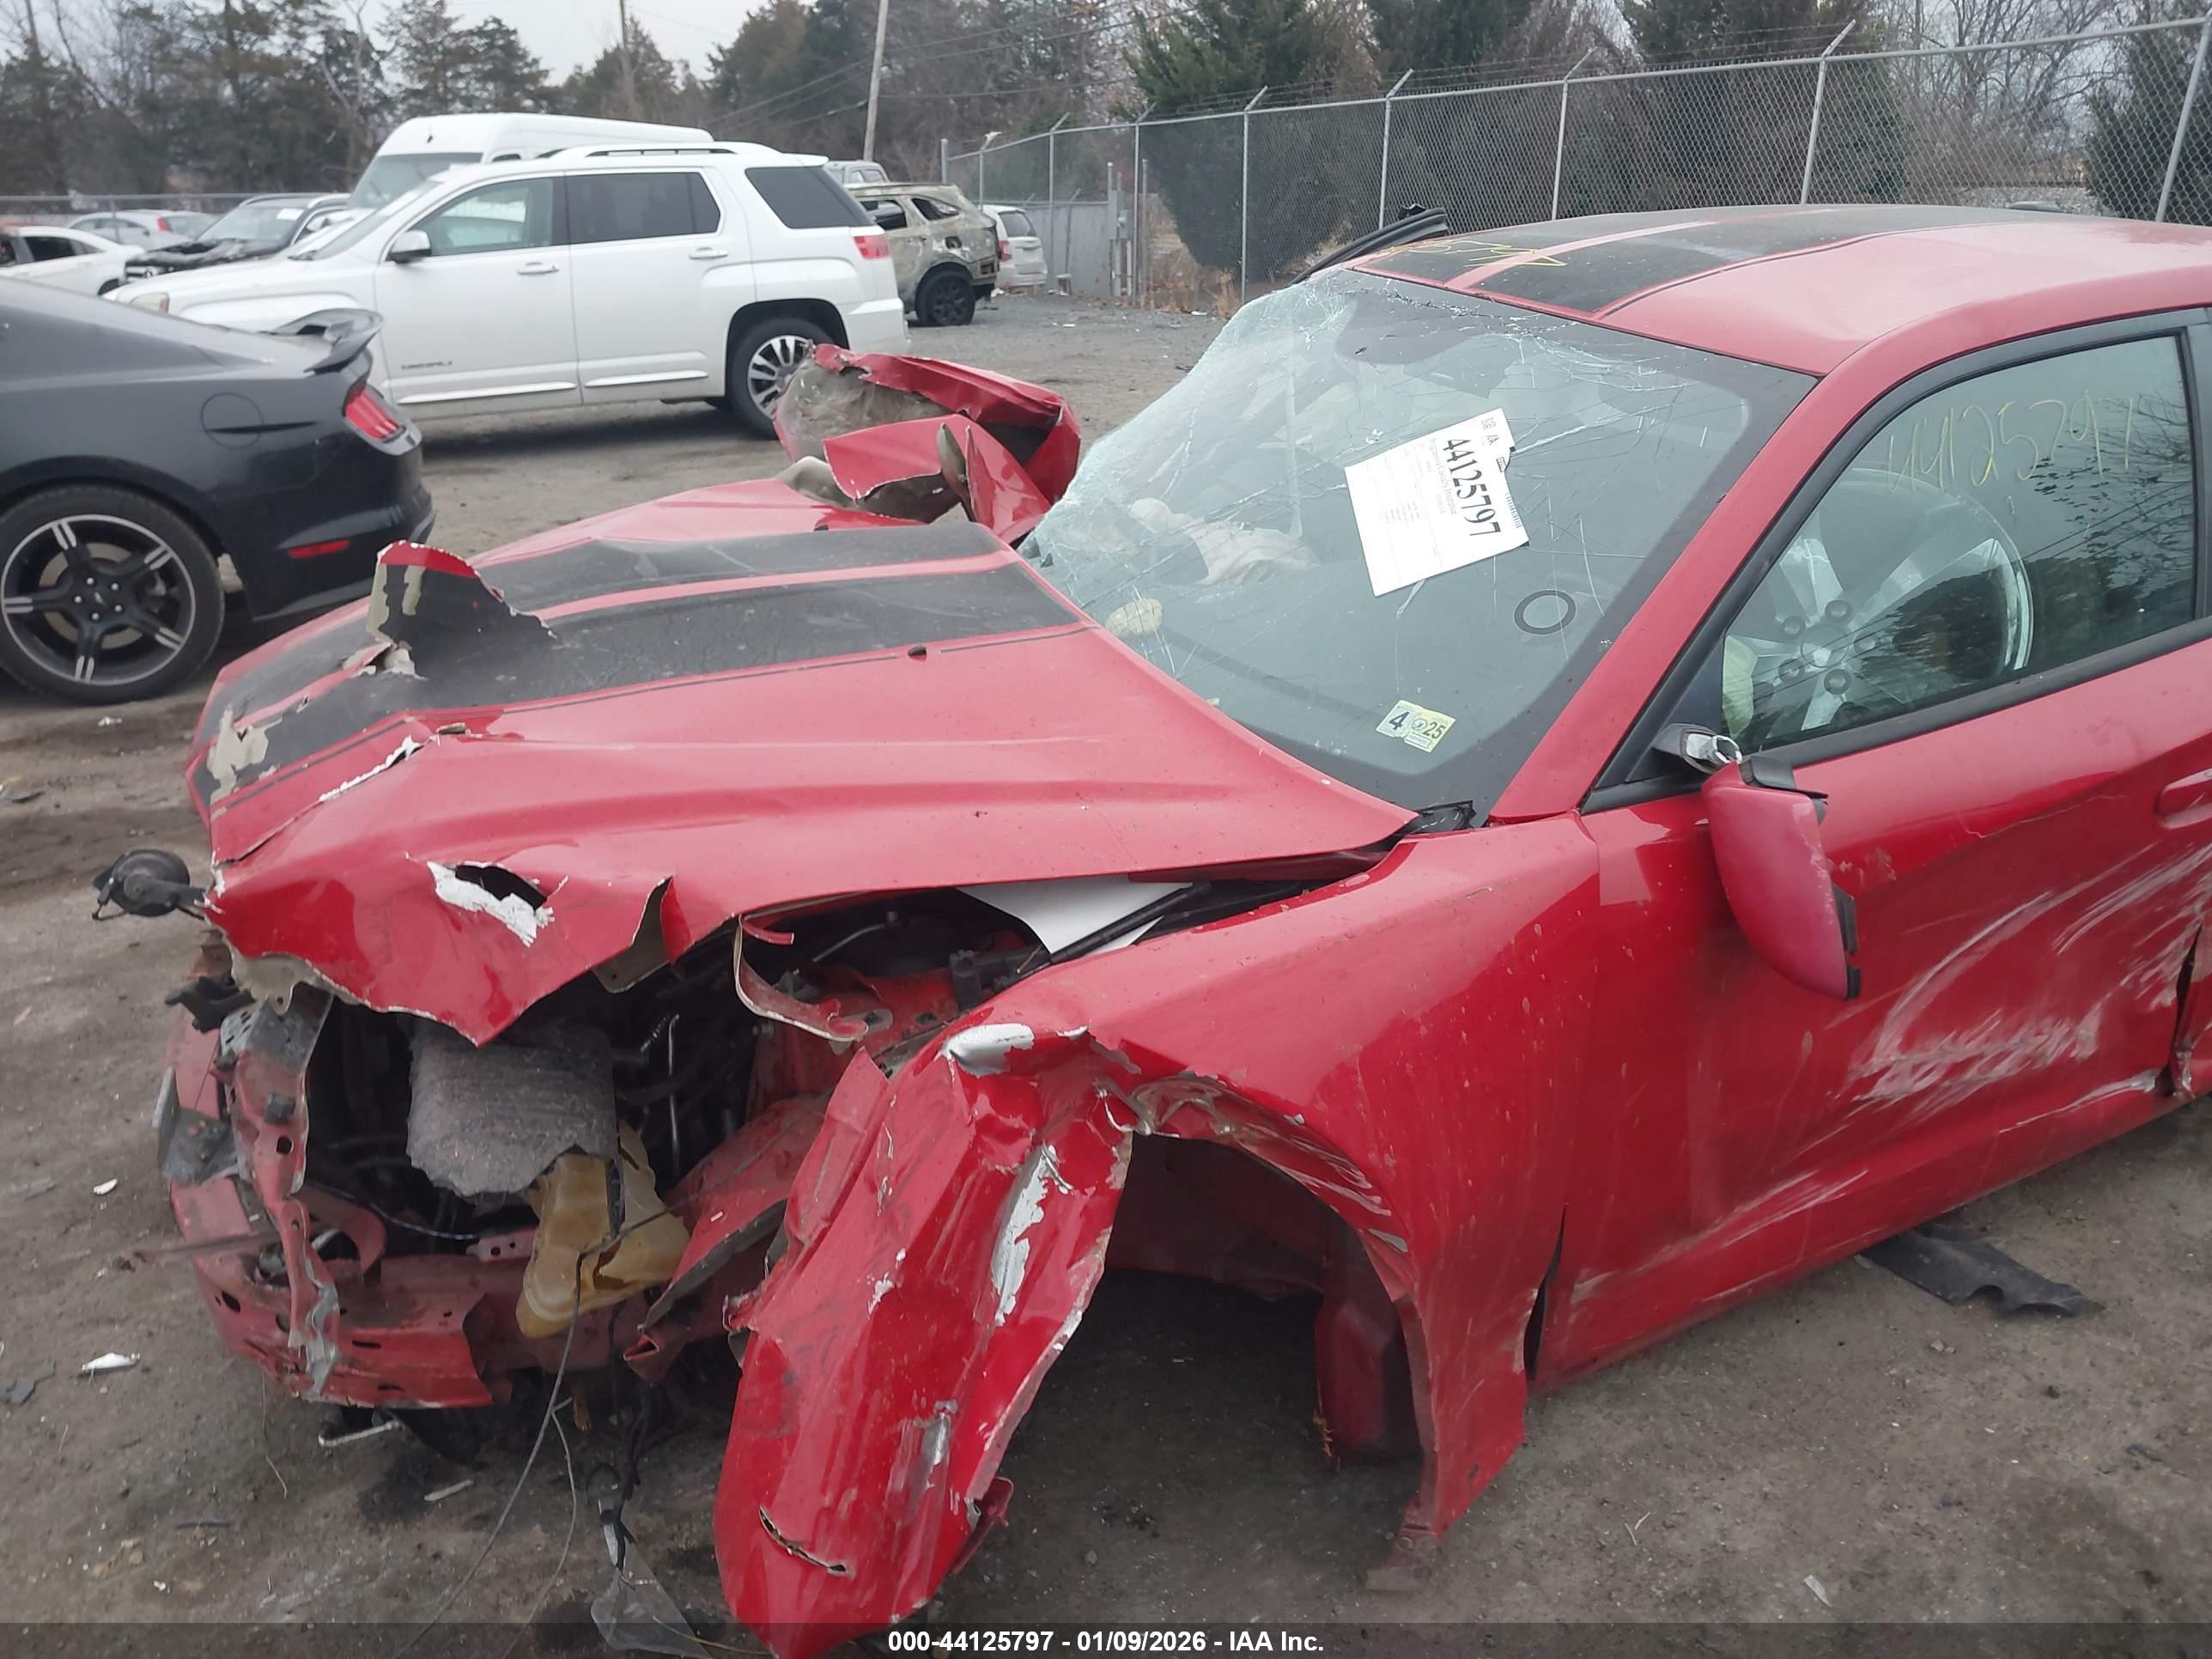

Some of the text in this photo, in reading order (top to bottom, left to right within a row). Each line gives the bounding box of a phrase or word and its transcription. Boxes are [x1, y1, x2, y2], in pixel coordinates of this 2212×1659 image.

[1443, 439, 1501, 537] 44125797
[1389, 711, 1447, 739] 4 25
